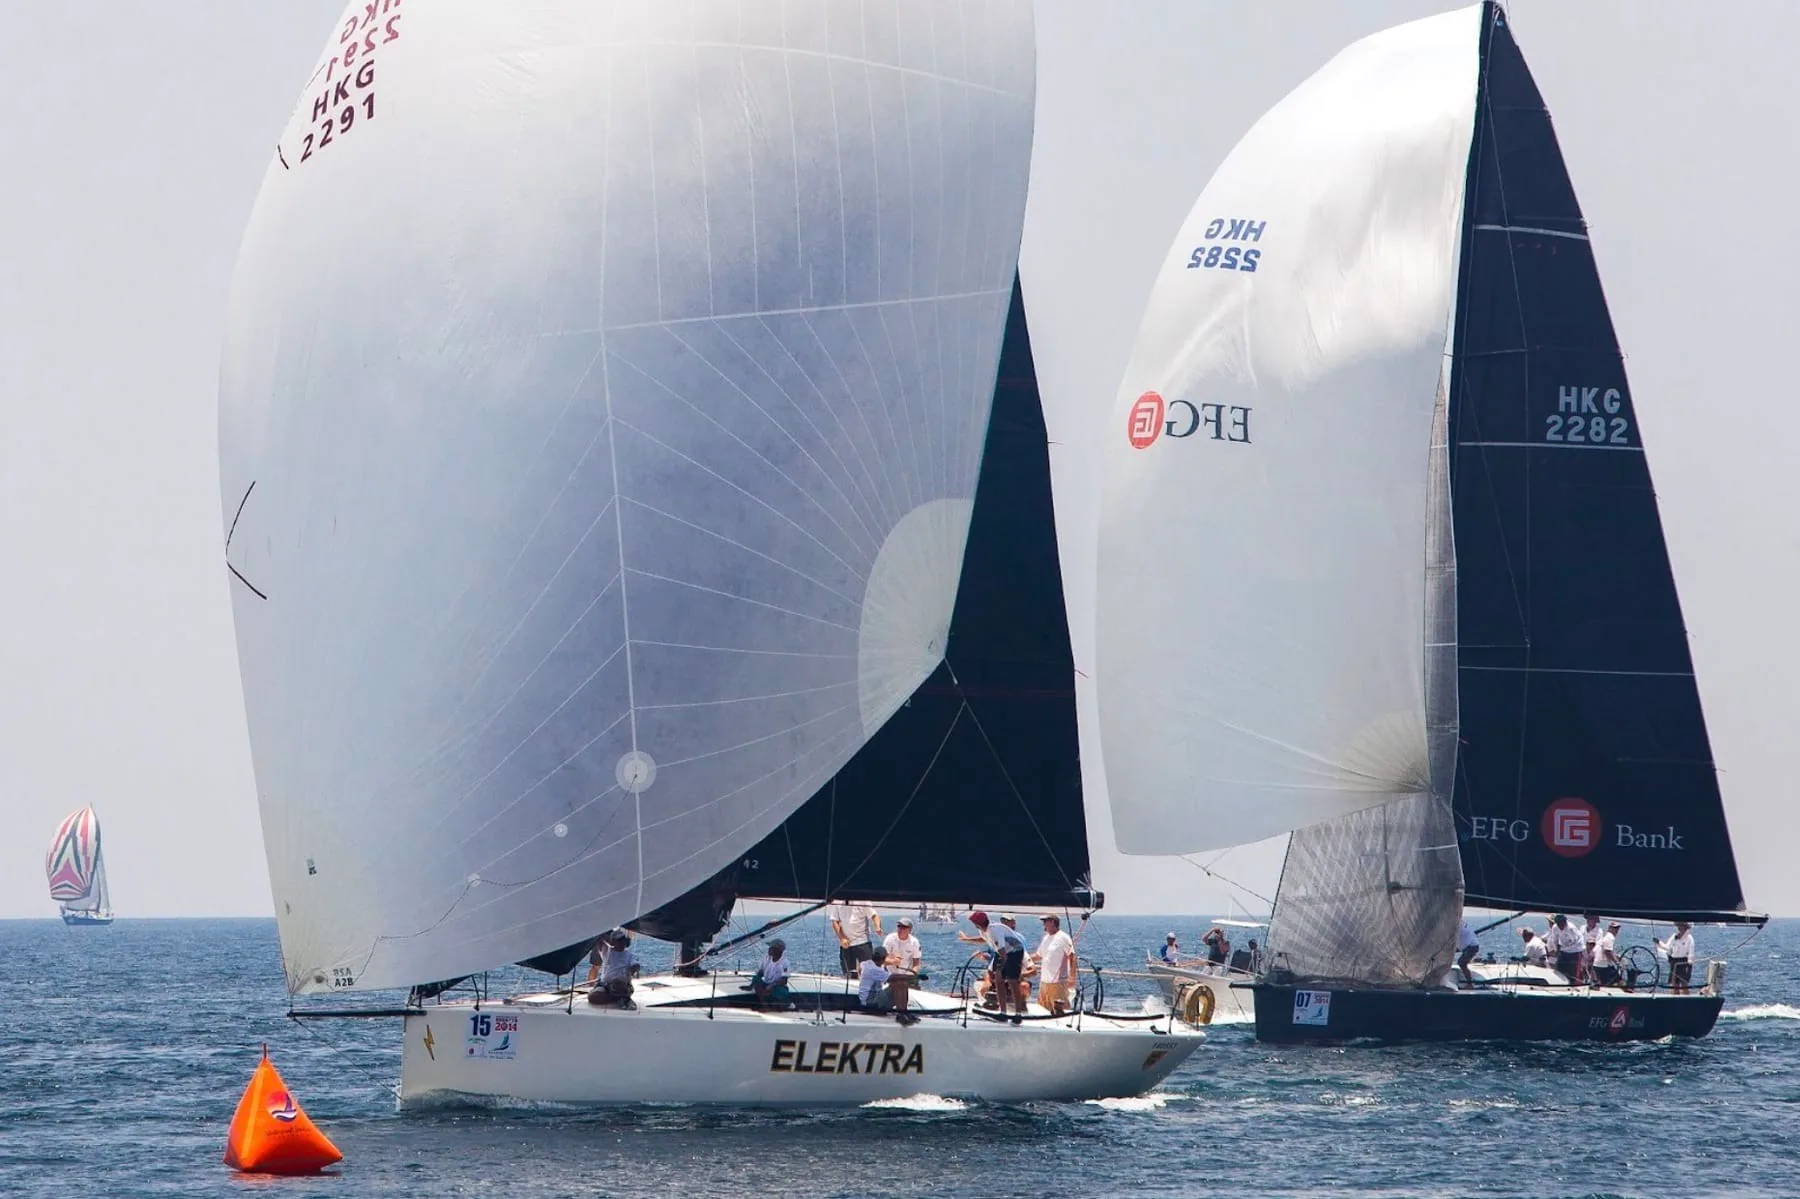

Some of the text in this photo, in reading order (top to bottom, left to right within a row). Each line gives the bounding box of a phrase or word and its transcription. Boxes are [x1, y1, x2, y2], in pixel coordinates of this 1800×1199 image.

[312, 59, 375, 123] HKG
[300, 92, 375, 163] 2291
[1559, 385, 1621, 415] HKG
[1545, 415, 1628, 444] 2282
[1470, 816, 1684, 850] EFG Bank
[1296, 992, 1311, 1008] 07
[470, 1014, 491, 1036] 15
[771, 1038, 924, 1075] ELEKTRA
